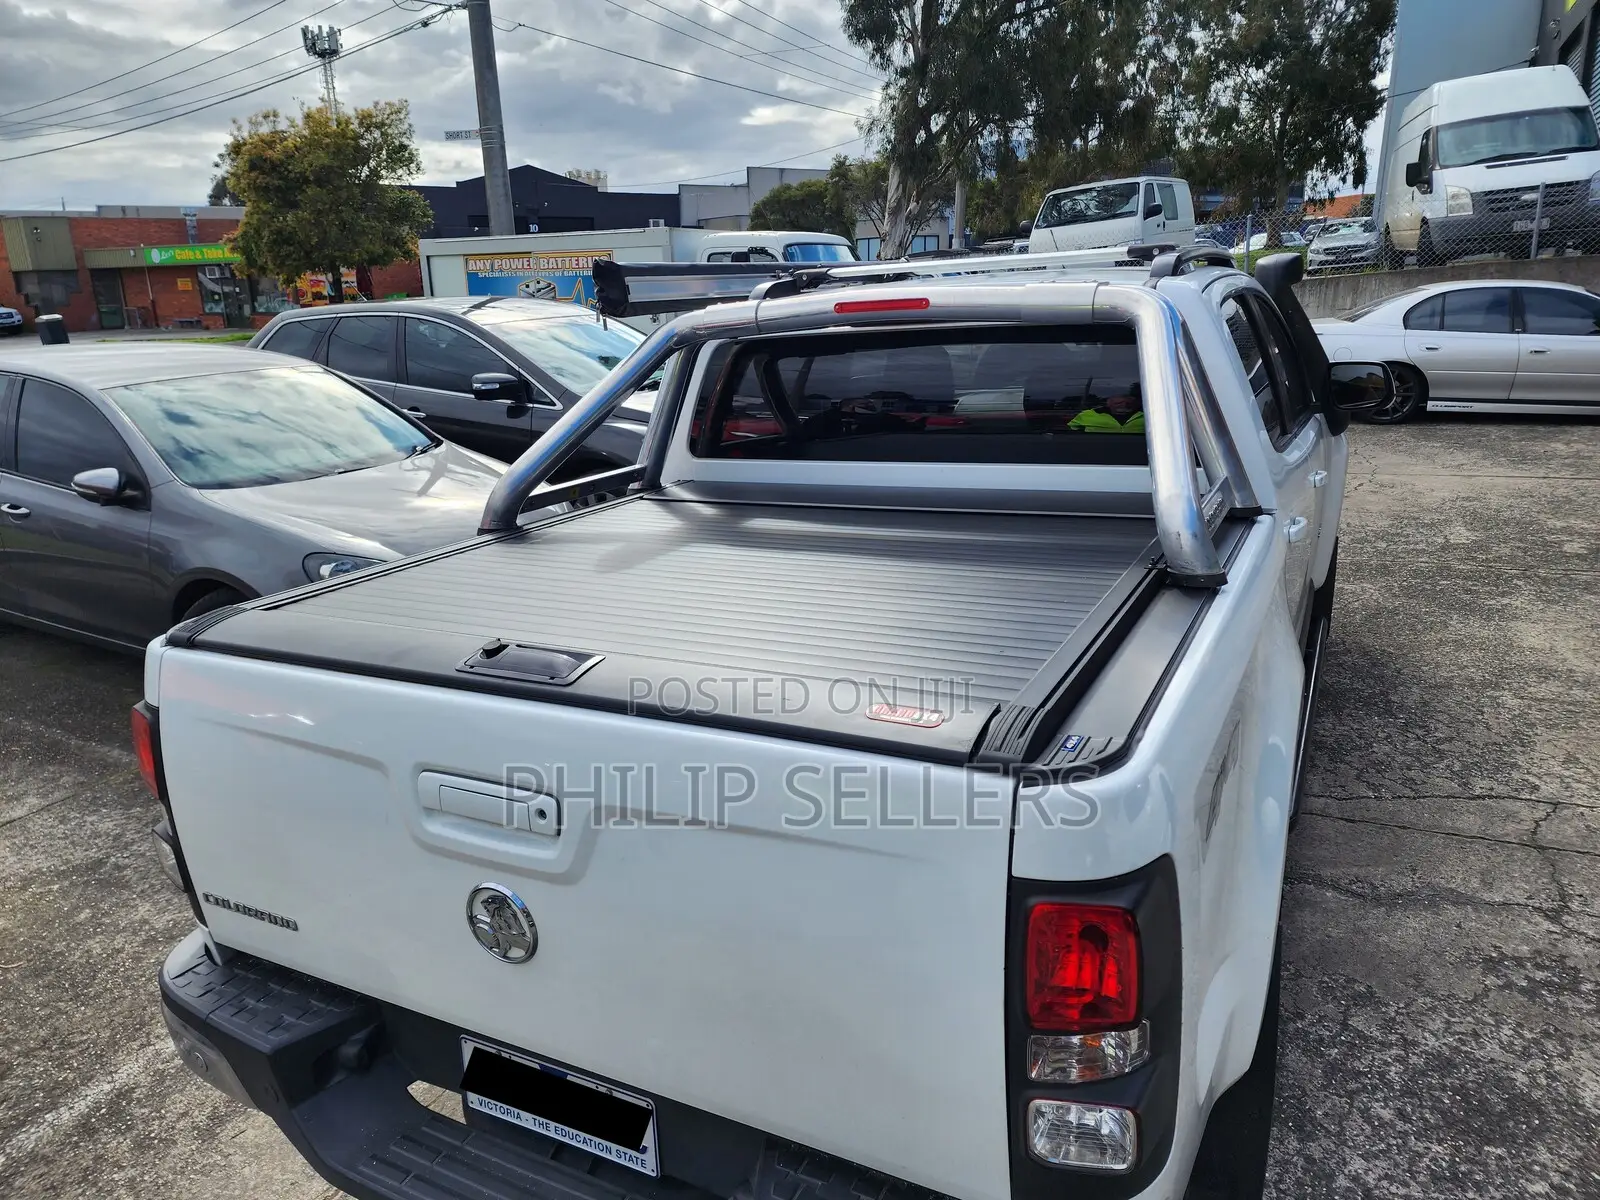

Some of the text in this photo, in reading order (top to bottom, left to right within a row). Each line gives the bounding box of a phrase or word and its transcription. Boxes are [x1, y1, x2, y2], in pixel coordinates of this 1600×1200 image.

[445, 130, 472, 140] SHORT ST
[529, 224, 538, 233] 10
[175, 248, 194, 260] Cafe
[195, 250, 202, 259] &
[203, 248, 222, 259] Take
[468, 255, 609, 271] ANY POWER BATTERI
[478, 1098, 522, 1121] VICTORIA
[532, 1117, 551, 1132] THE
[554, 1126, 612, 1156] EDUCATION
[615, 1149, 647, 1169] STATE
